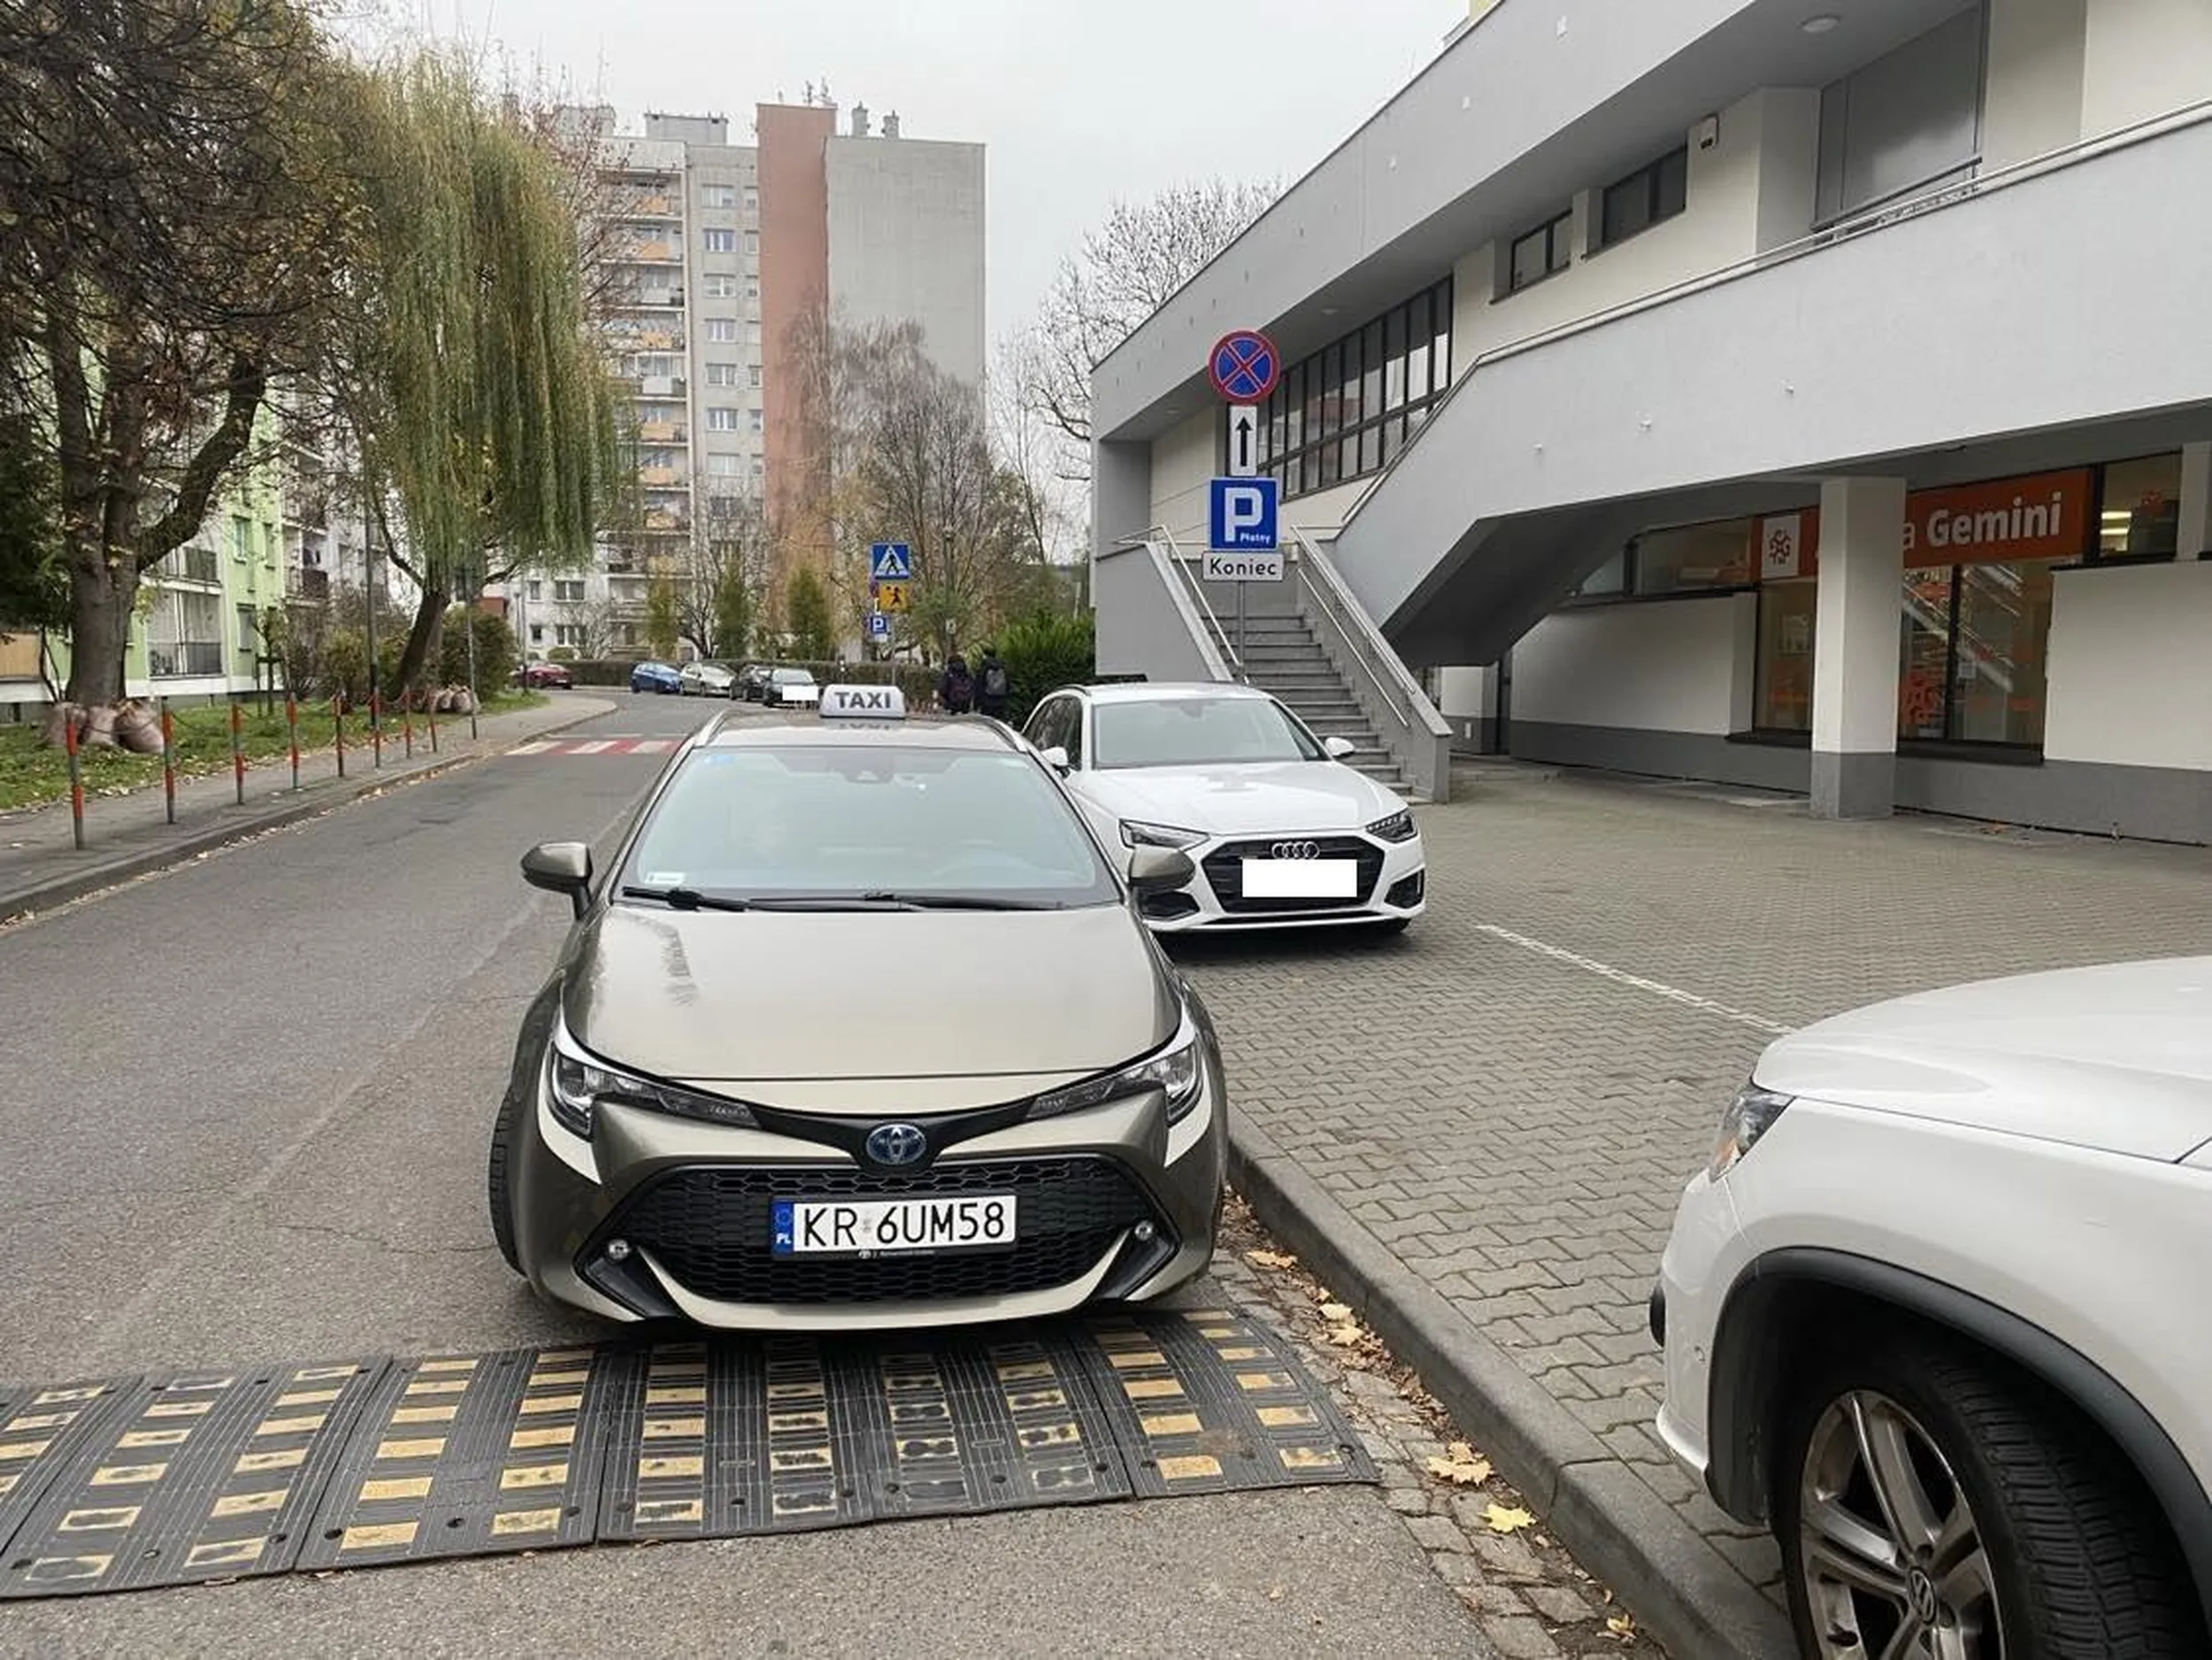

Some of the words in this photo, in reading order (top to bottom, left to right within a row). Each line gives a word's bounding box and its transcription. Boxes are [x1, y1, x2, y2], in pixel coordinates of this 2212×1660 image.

[1225, 488, 1263, 542] P
[1926, 491, 2062, 548] Gemini
[1210, 557, 1276, 575] Koniec
[872, 617, 884, 632] P
[834, 692, 891, 709] TAXI
[804, 1207, 857, 1247] KR
[876, 1202, 1004, 1244] 6UM58
